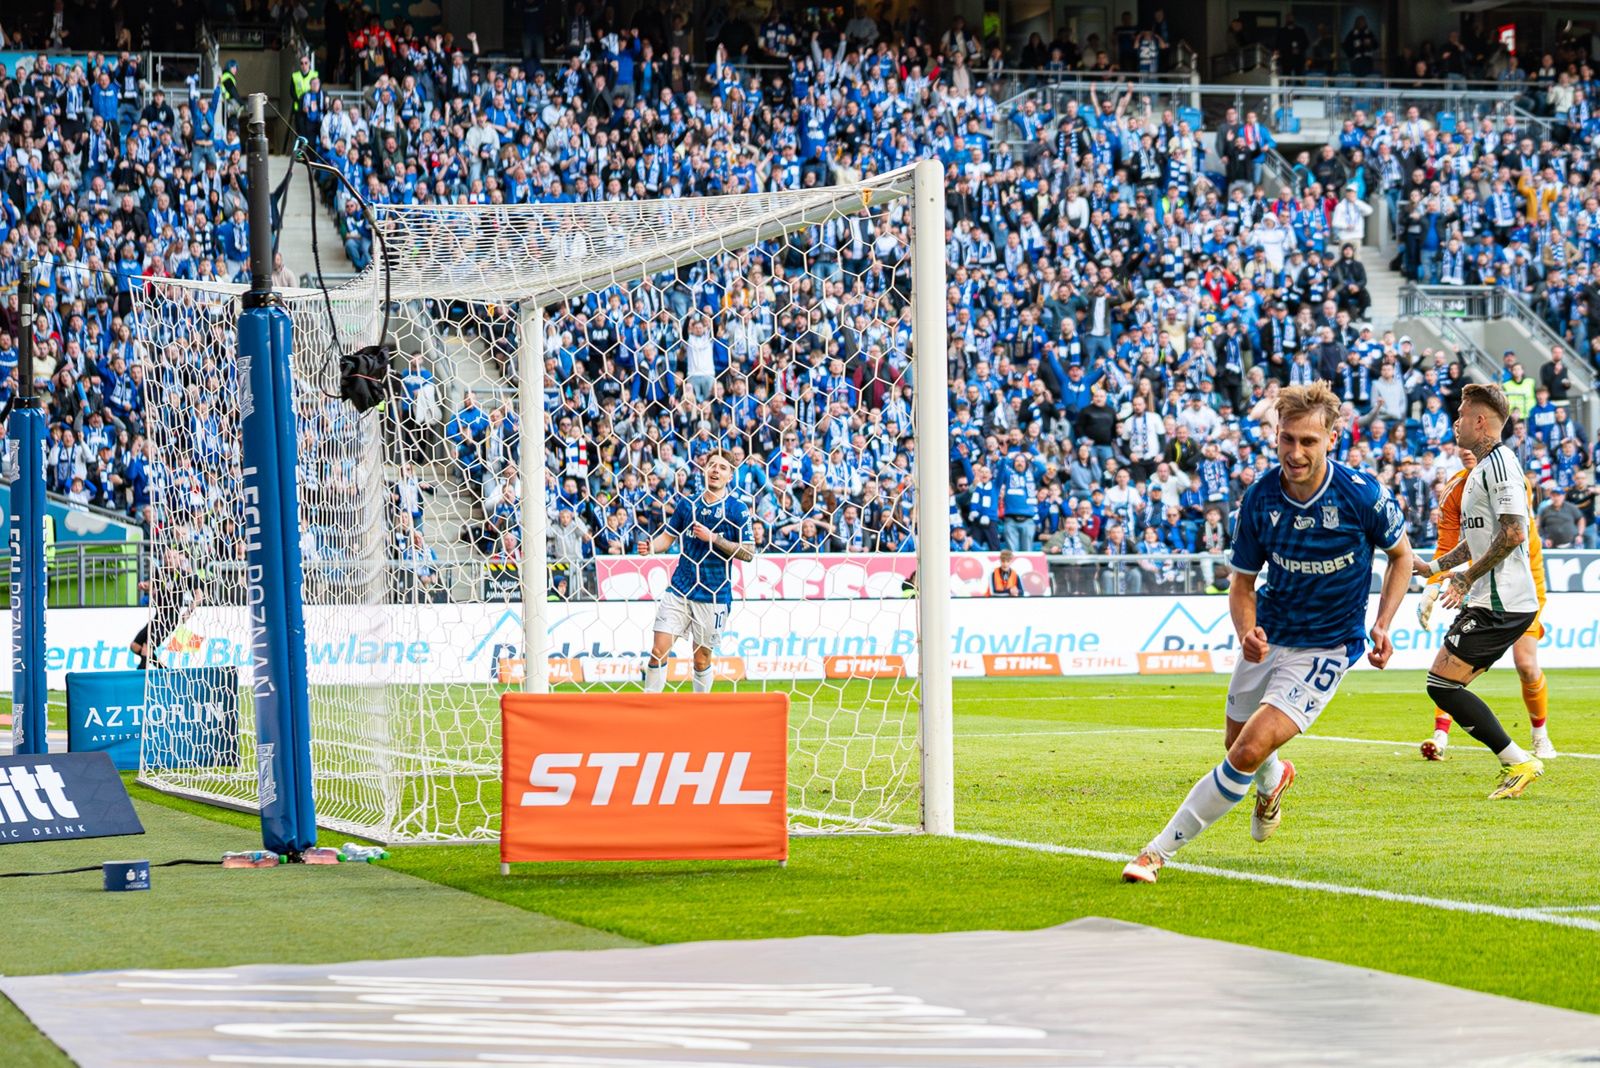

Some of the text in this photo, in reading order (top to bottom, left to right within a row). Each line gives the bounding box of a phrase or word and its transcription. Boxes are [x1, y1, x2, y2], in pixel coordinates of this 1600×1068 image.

[1272, 552, 1355, 575] SUPERBET
[889, 626, 1100, 656] Bdowlane
[757, 660, 815, 673] STIHL
[834, 658, 895, 673] STIHL
[993, 656, 1053, 670] STIHL
[1072, 656, 1129, 668] STIHL
[1146, 654, 1207, 669] STIHL
[1304, 656, 1342, 692] 15
[84, 701, 224, 729] AZTORIN
[520, 752, 773, 806] STIHL
[32, 824, 87, 836] DRINK
